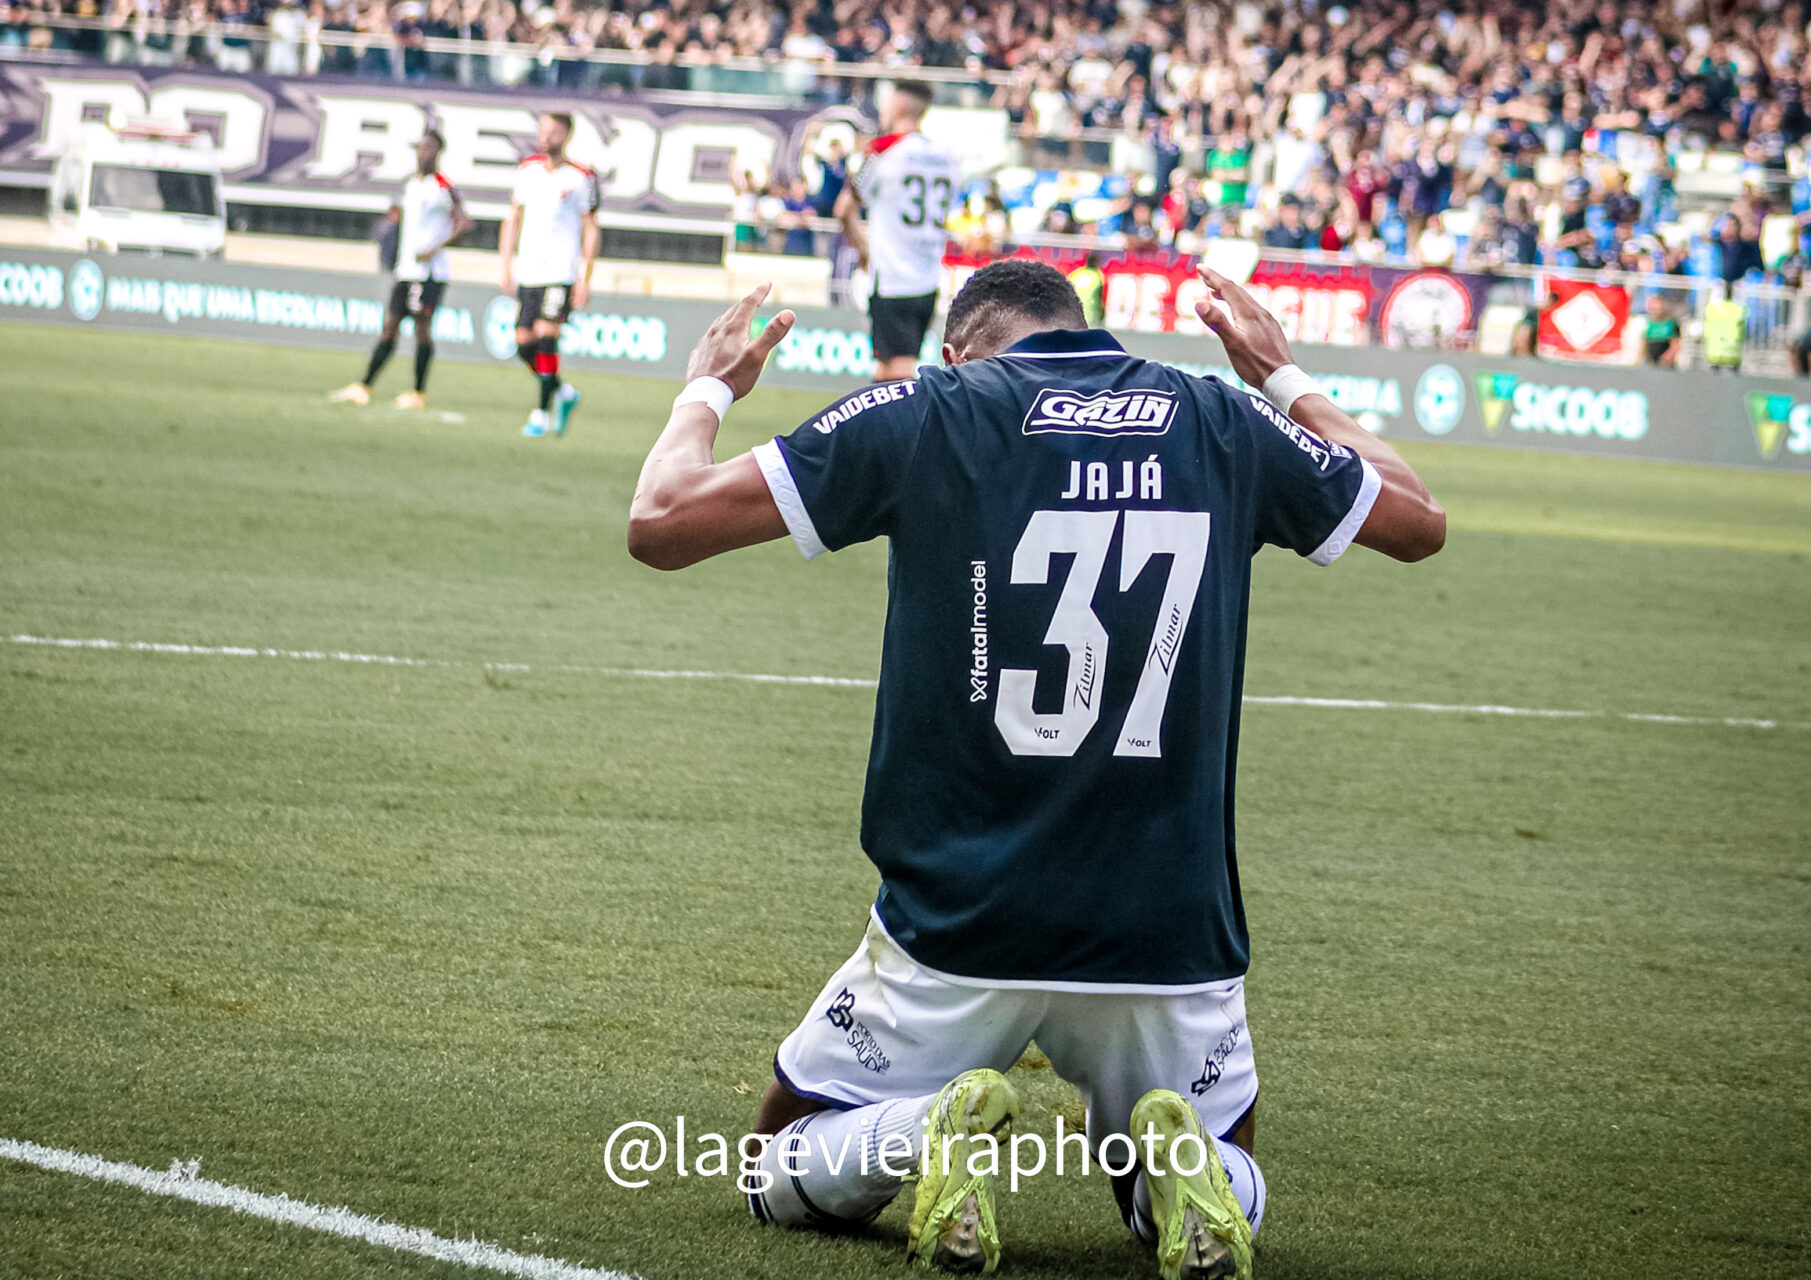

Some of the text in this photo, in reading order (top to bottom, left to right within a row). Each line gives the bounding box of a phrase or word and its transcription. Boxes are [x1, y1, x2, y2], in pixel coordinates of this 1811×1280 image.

[902, 173, 952, 229] 33
[1174, 277, 1367, 345] SNGUE
[777, 327, 880, 377] SICOO
[812, 380, 918, 435] VAIDEBET
[1510, 381, 1650, 441] SICOOB
[1060, 453, 1163, 501] JAJÁ
[993, 509, 1211, 758] 37
[1148, 604, 1184, 677] Zilmar
[1073, 642, 1096, 711] Zilmar
[847, 1029, 886, 1075] SAÚDE
